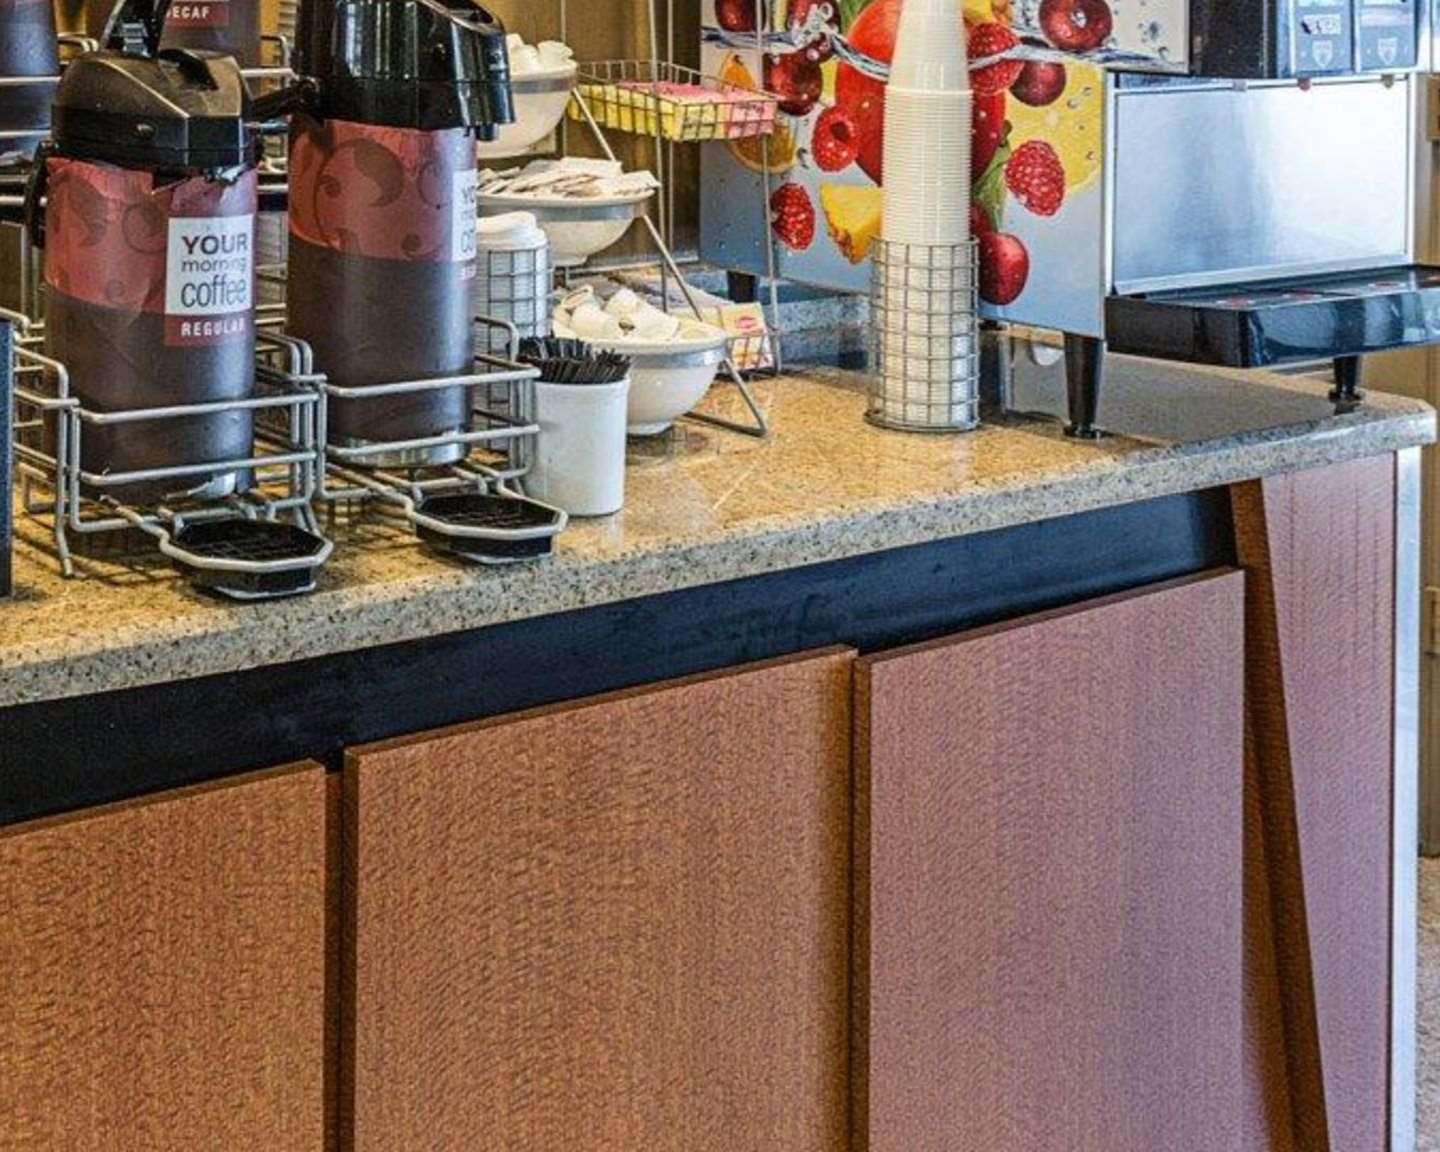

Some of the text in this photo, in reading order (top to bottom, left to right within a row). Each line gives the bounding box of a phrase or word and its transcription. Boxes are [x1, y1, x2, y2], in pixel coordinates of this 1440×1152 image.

[180, 232, 248, 255] YOUR
[180, 274, 247, 309] coffee
[180, 316, 247, 338] REGULAR
